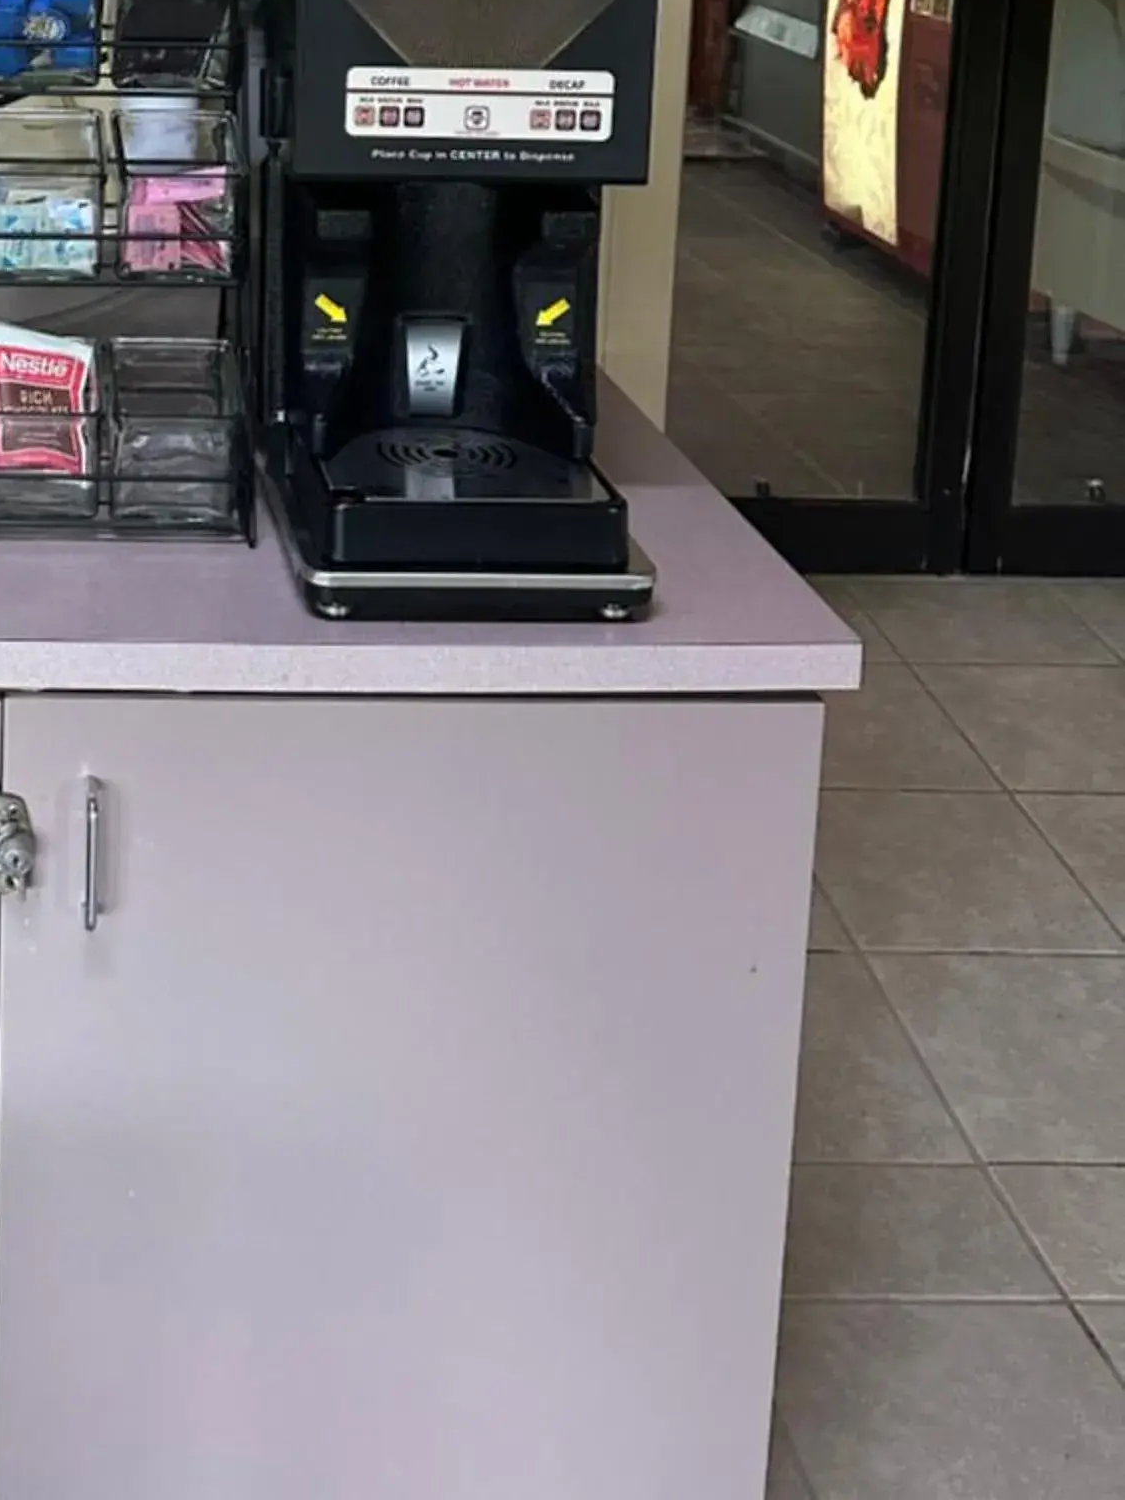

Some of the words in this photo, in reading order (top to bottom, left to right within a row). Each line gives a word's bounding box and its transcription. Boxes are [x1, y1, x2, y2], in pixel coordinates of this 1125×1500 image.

[370, 75, 410, 86] COFFEE
[549, 79, 586, 90] DECAF
[409, 149, 433, 161] Cup
[449, 149, 501, 161] CENTER
